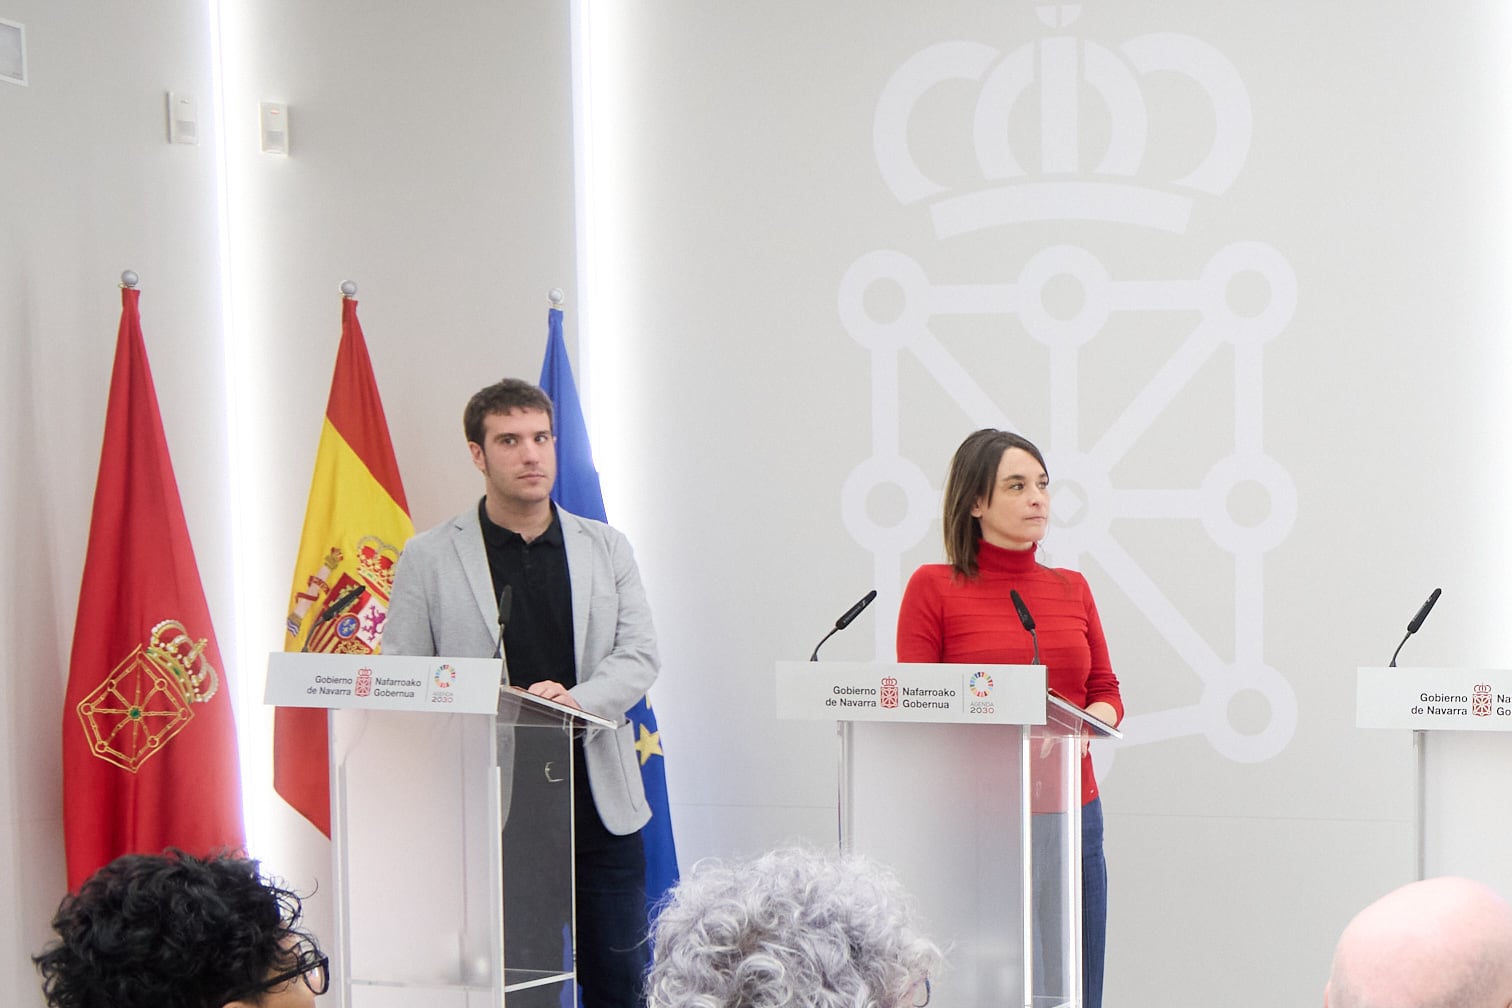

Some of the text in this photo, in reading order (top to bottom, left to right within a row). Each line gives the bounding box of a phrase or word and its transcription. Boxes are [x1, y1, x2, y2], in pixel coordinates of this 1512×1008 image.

[315, 675, 353, 685] Gobierno
[375, 678, 422, 687] Nafarroako
[306, 686, 351, 696] de Navarra
[374, 688, 415, 698] Gobernua
[833, 685, 877, 696] Gobierno
[902, 687, 956, 697] Nafarroako
[825, 697, 877, 708] de Navarra
[1420, 693, 1468, 703] Gobierno
[902, 699, 950, 709] Gobernua
[1411, 705, 1468, 716] de Navarra
